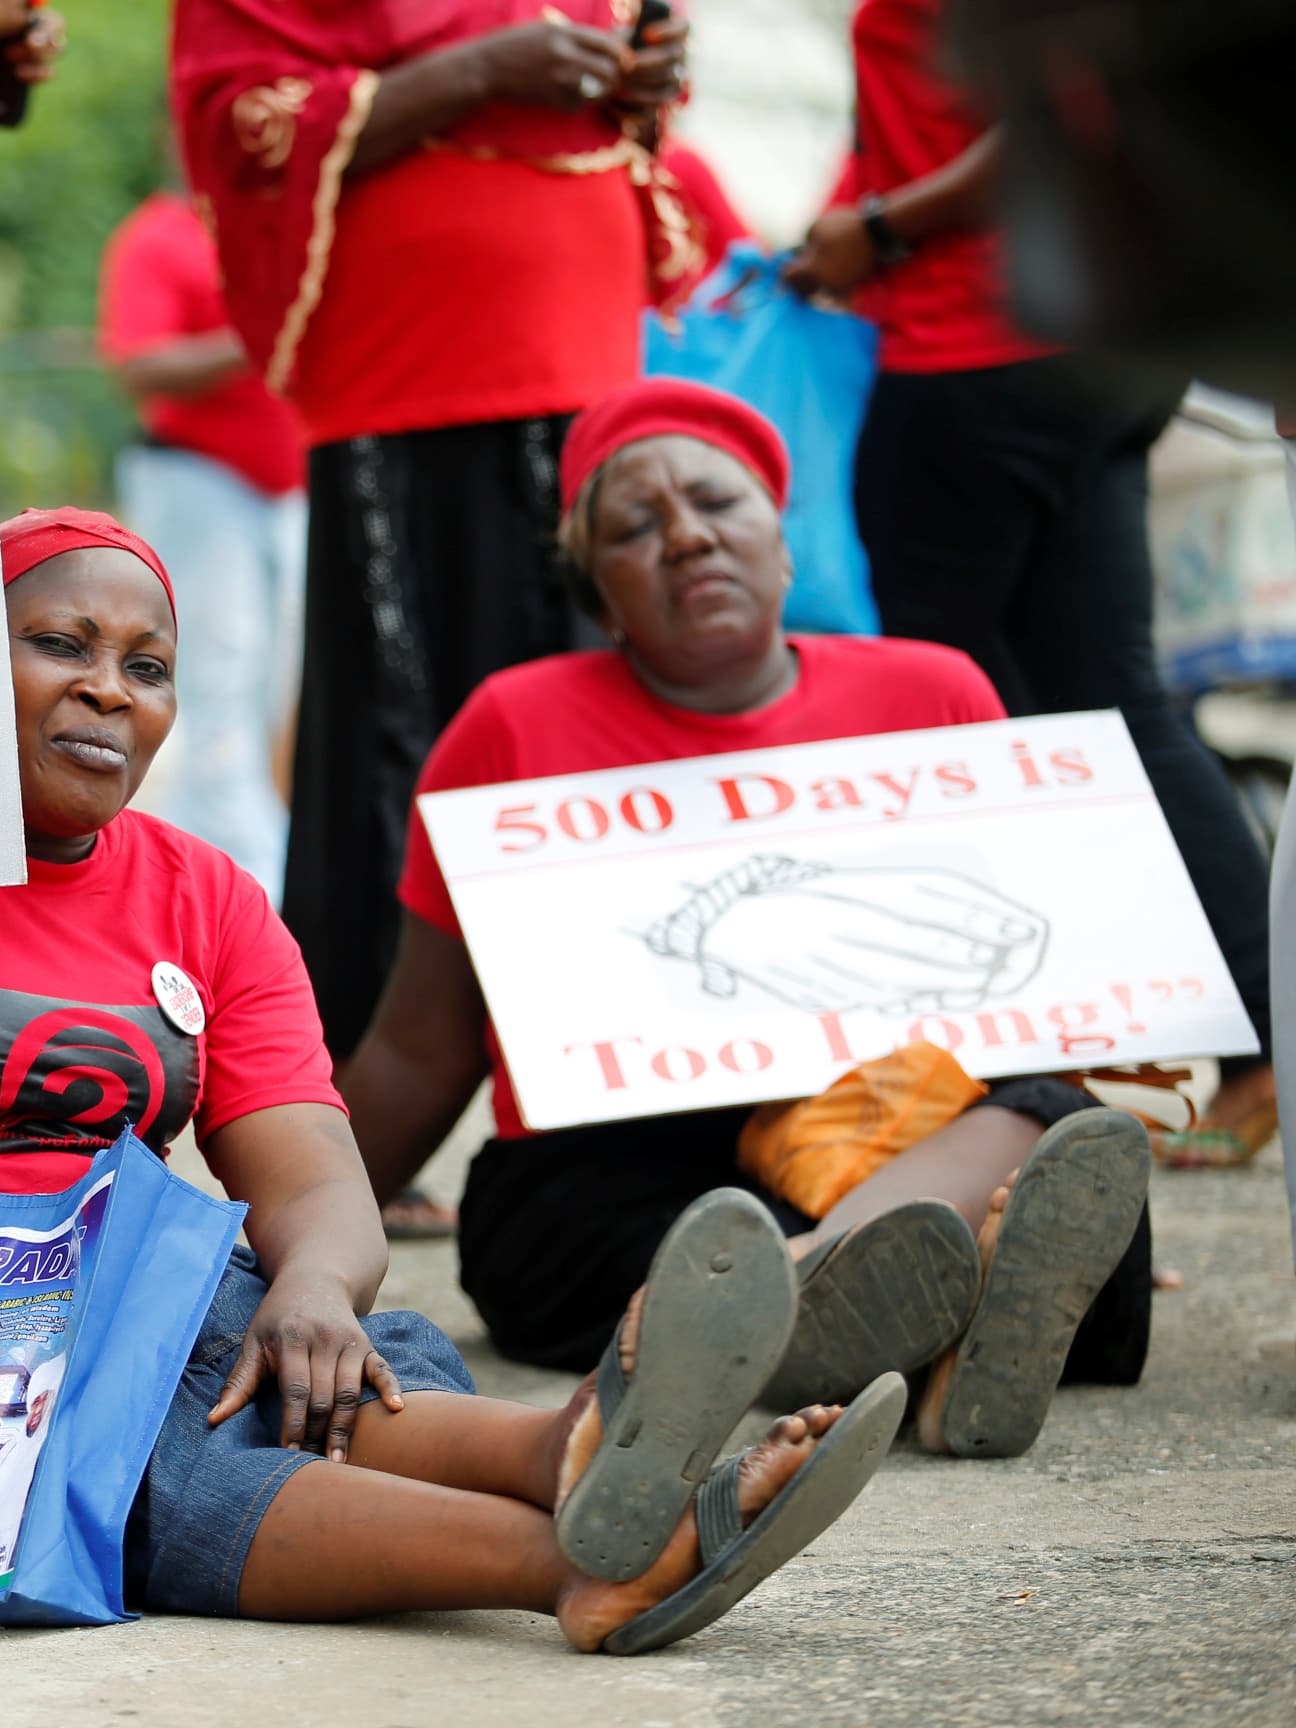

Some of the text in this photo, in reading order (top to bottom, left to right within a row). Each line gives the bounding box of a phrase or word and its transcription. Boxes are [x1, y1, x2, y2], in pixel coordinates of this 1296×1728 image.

[494, 740, 1095, 853] 500 Days is
[566, 1034, 775, 1093] Too
